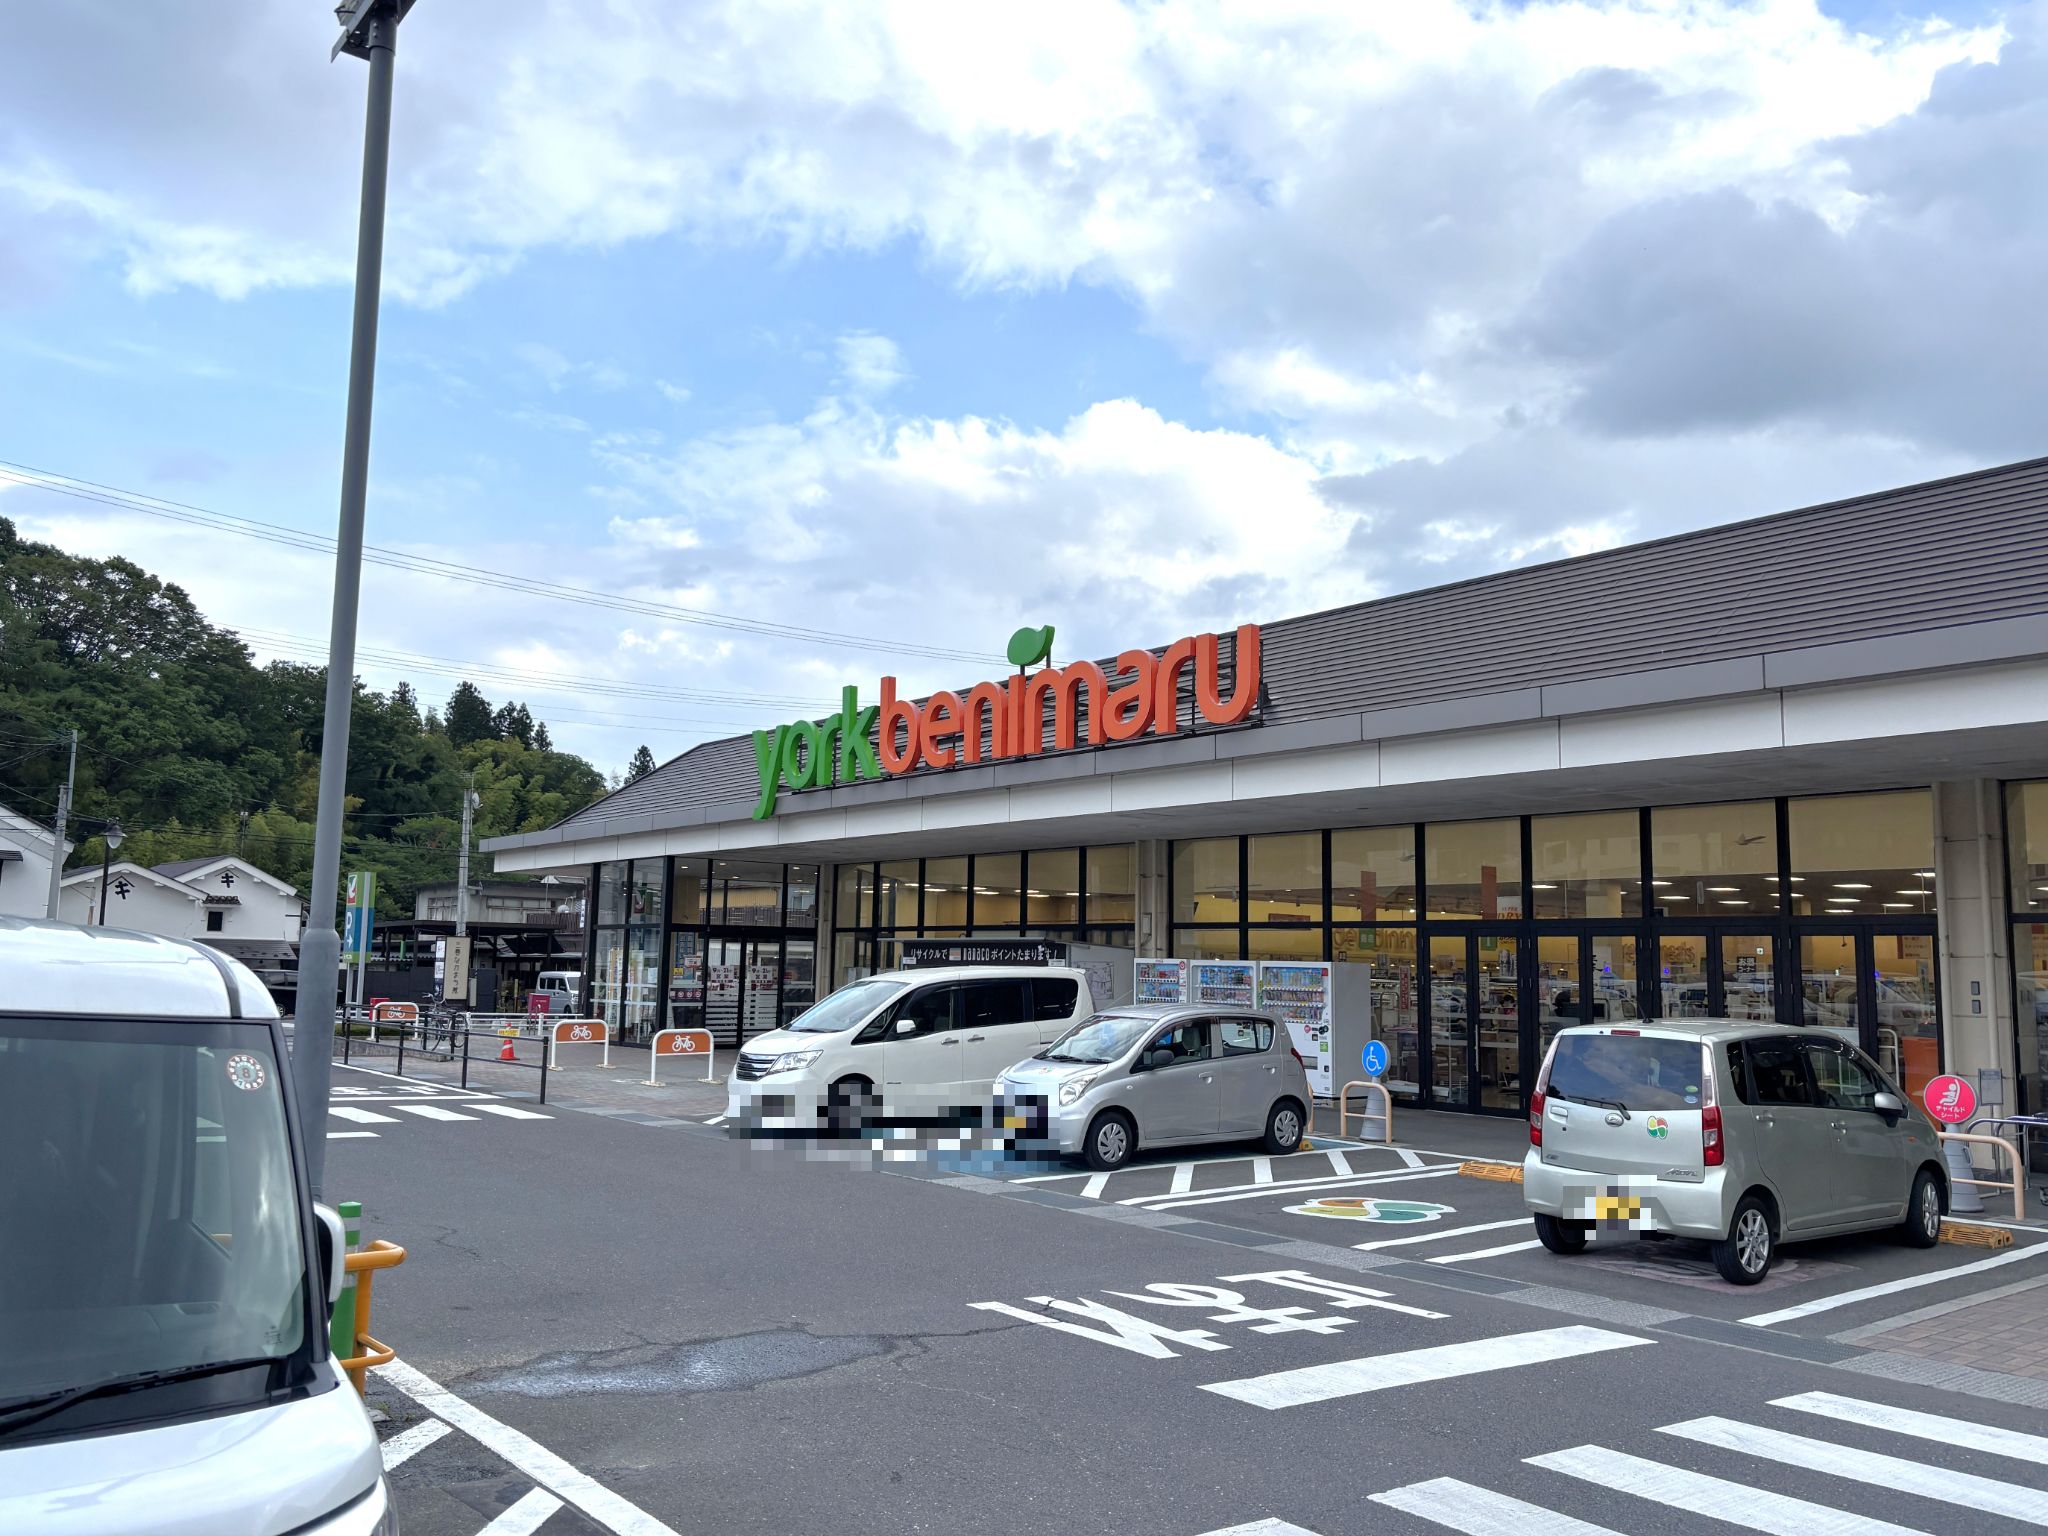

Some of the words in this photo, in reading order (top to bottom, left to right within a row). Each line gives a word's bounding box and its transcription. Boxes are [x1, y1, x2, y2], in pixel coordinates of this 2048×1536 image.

[963, 947, 989, 960] nanaco
[1936, 1105, 1966, 1113] チャイルド
[966, 1270, 1451, 1359] 止まれ
